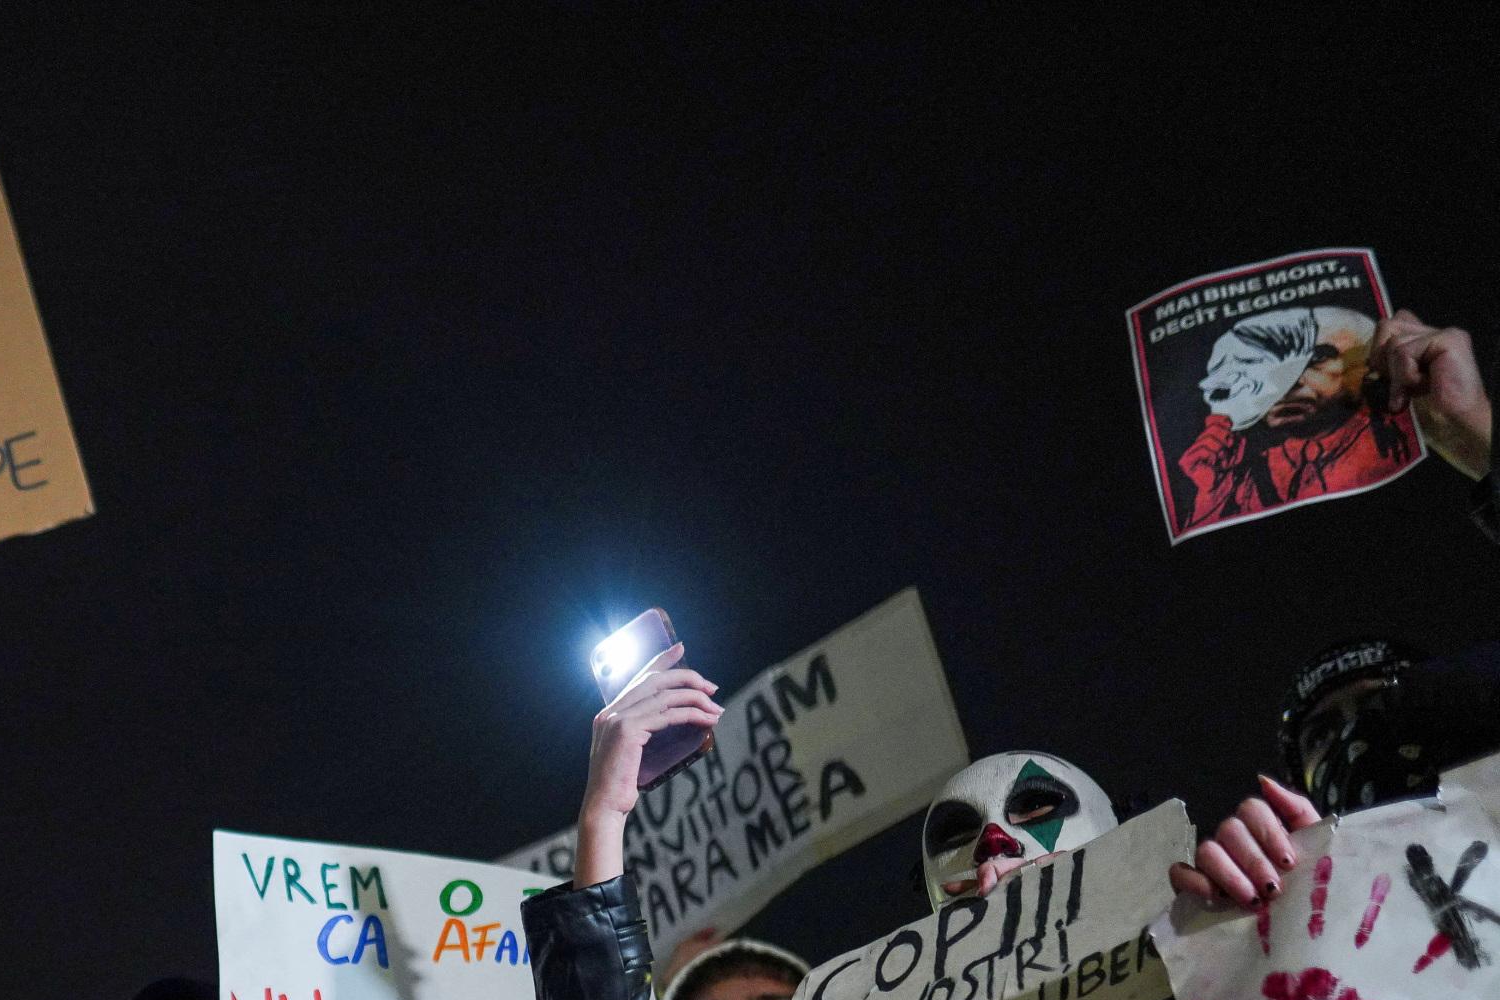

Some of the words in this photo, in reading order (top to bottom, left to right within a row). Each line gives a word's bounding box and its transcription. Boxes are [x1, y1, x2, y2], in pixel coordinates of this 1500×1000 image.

[1153, 292, 1199, 322] MAI
[1202, 276, 1262, 304] BINE
[747, 654, 837, 755] AM
[649, 838, 740, 937] ARA
[744, 760, 867, 870] MEA
[241, 852, 389, 912] VREM
[439, 880, 485, 917] O
[316, 914, 390, 970] CA
[433, 917, 531, 967] AFA
